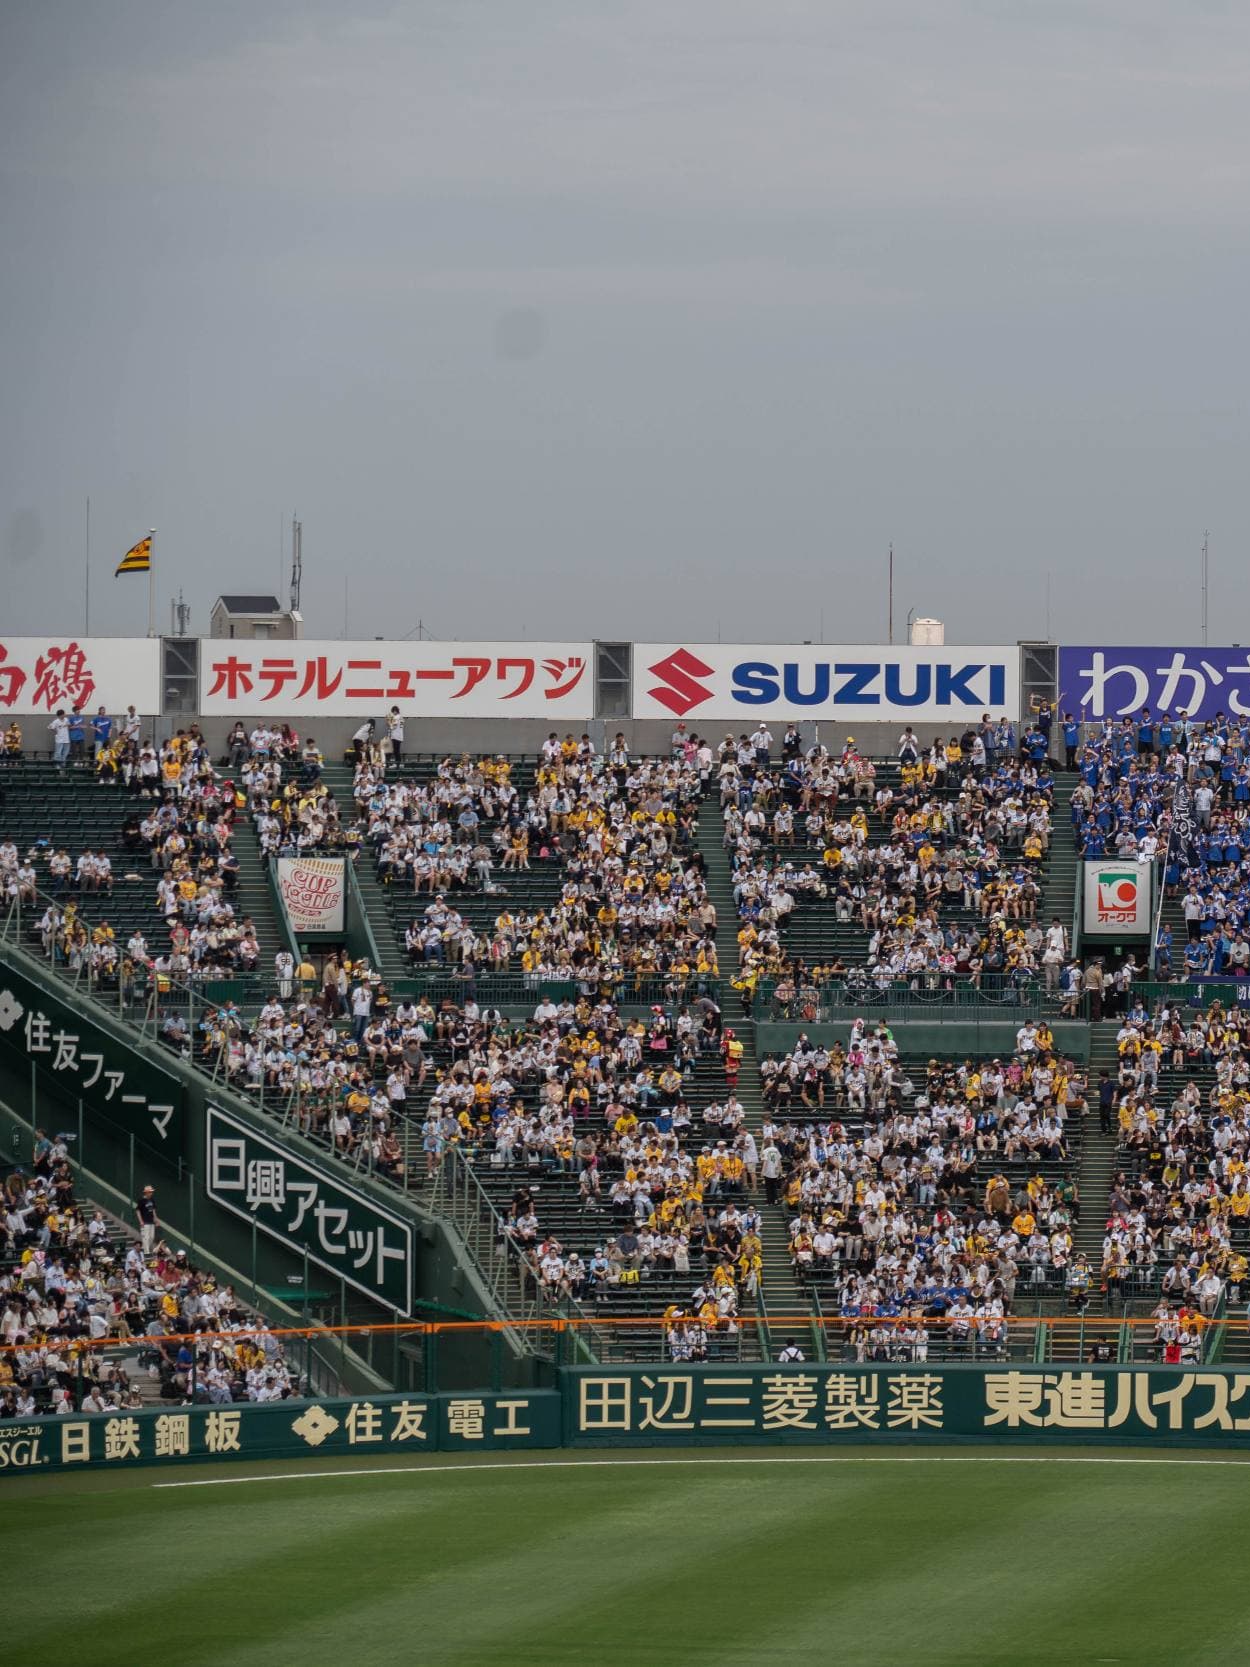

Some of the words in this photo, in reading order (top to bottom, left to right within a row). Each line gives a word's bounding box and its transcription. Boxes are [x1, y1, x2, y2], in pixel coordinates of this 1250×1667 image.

[207, 656, 586, 702] ホテルニューアワジ
[730, 661, 1005, 707] SUZUKI
[1098, 912, 1136, 923] オークワ
[24, 1011, 174, 1139] 住友ファーマ
[212, 1138, 405, 1285] 日興アセット
[345, 1399, 531, 1445] 住友電工
[579, 1373, 944, 1431] 田辺三菱製薬
[61, 1410, 242, 1463] 日鉄鋼板
